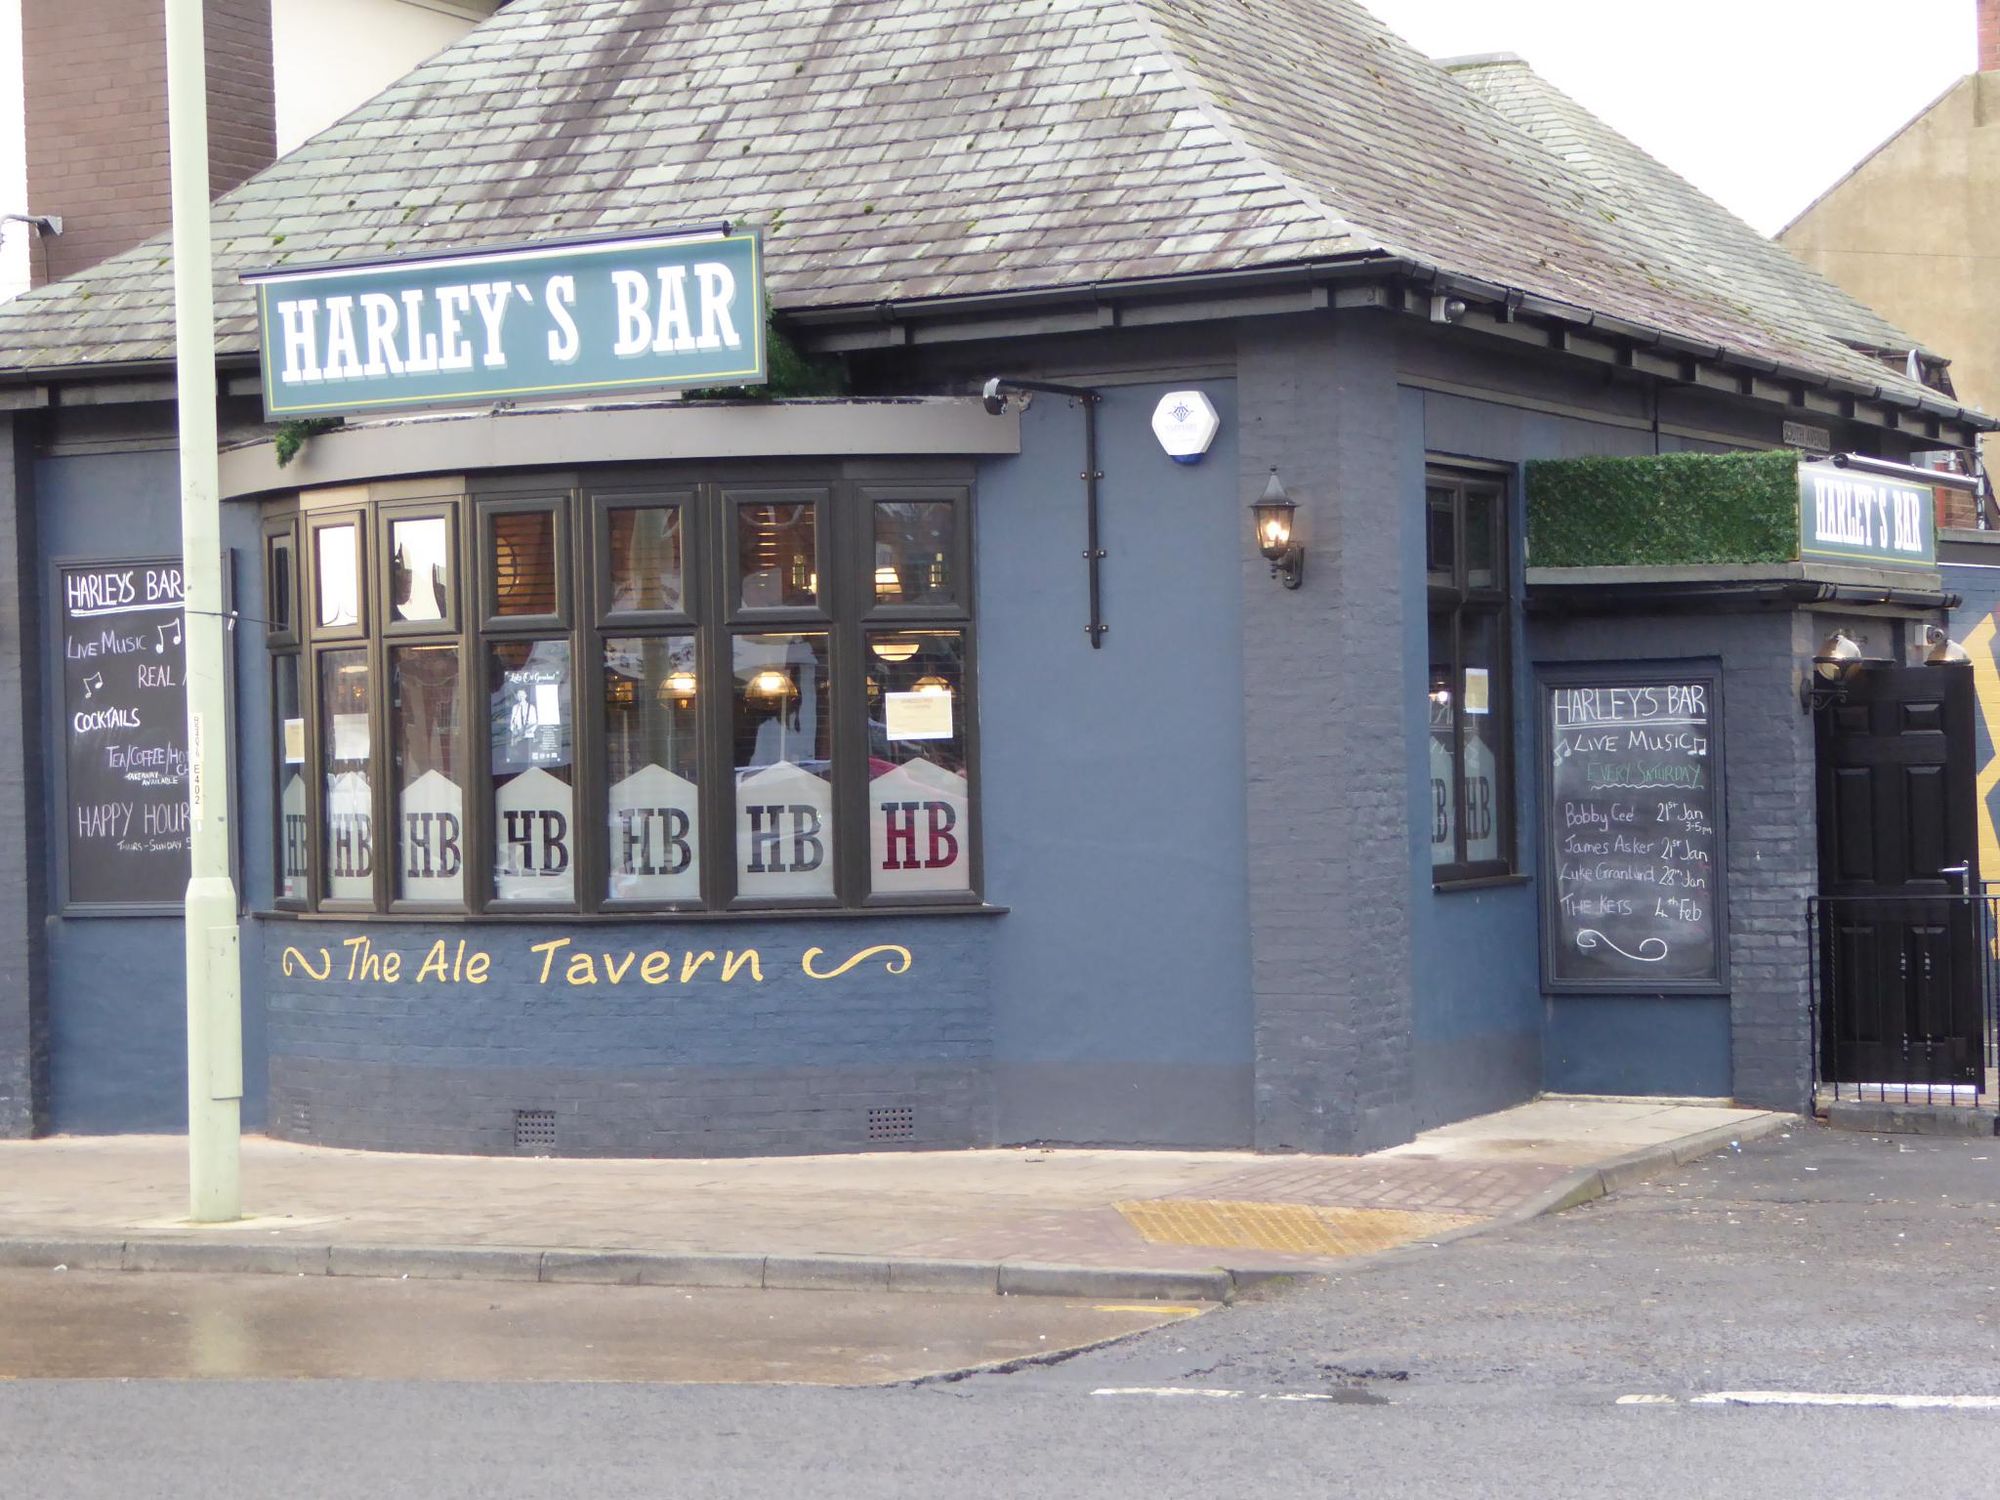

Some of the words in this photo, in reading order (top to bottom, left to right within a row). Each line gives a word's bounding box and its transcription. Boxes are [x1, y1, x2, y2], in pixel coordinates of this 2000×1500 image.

[612, 262, 741, 358] BAR
[1893, 490, 1922, 553] BAR
[68, 571, 136, 608] HARLEYS
[146, 569, 185, 599] BAR
[138, 664, 176, 689] REAL
[74, 707, 141, 733] COCKTAILS
[1667, 685, 1706, 715] BAR
[142, 775, 178, 787] AVAILABLE
[78, 802, 133, 838] HAPPY
[1465, 776, 1491, 840] HB
[1565, 801, 1609, 832] Bobby
[1677, 802, 1704, 821] Jan
[334, 813, 373, 877] HB
[407, 813, 461, 878] HB
[503, 810, 570, 877] HB
[619, 807, 692, 876] HB
[745, 805, 824, 873] HB
[880, 801, 959, 870] HB
[1565, 834, 1609, 855] James
[1614, 834, 1655, 855] Asker
[1680, 840, 1708, 862] Jan
[1559, 863, 1593, 882] Luke
[1681, 870, 1706, 889] Jan
[1560, 893, 1593, 916] THE
[1679, 898, 1702, 922] Feb
[343, 936, 401, 982] The
[416, 939, 491, 984] Ale
[531, 937, 764, 986] Tavern
